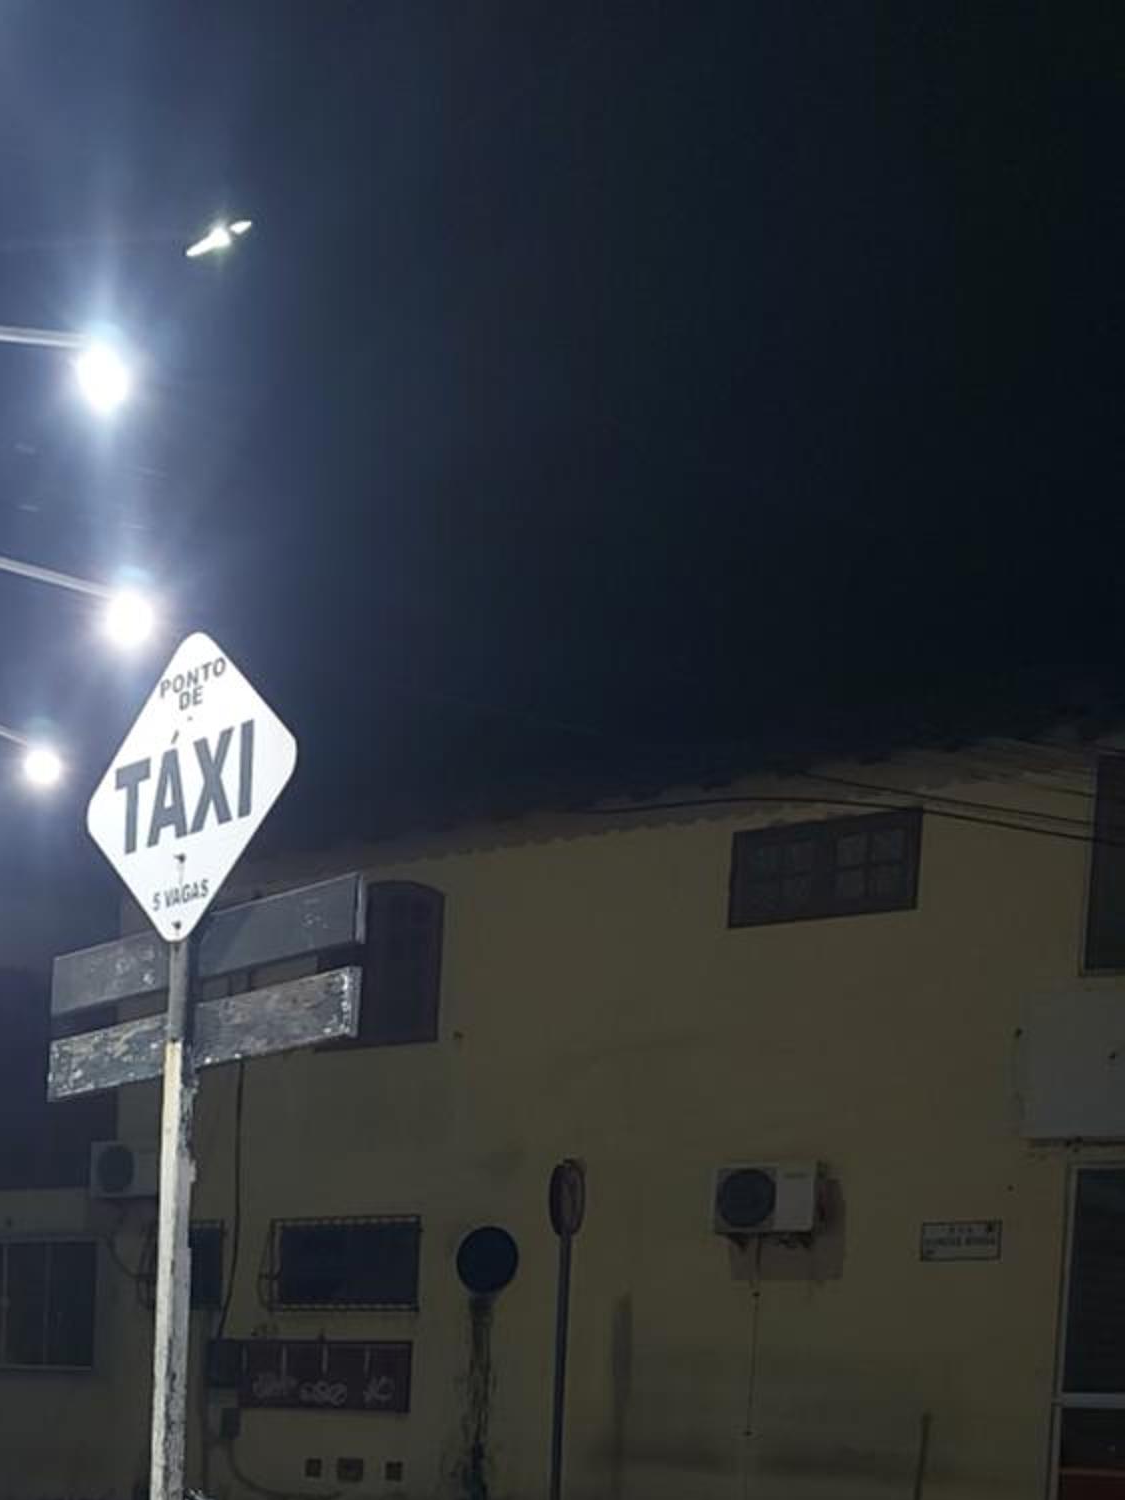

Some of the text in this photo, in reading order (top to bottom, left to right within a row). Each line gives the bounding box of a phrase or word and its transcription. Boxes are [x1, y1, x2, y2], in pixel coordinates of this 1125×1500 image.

[159, 656, 226, 699] PONTO
[178, 686, 204, 711] DE
[115, 719, 255, 855] TÁXI
[152, 879, 210, 912] 5 VAGAS
